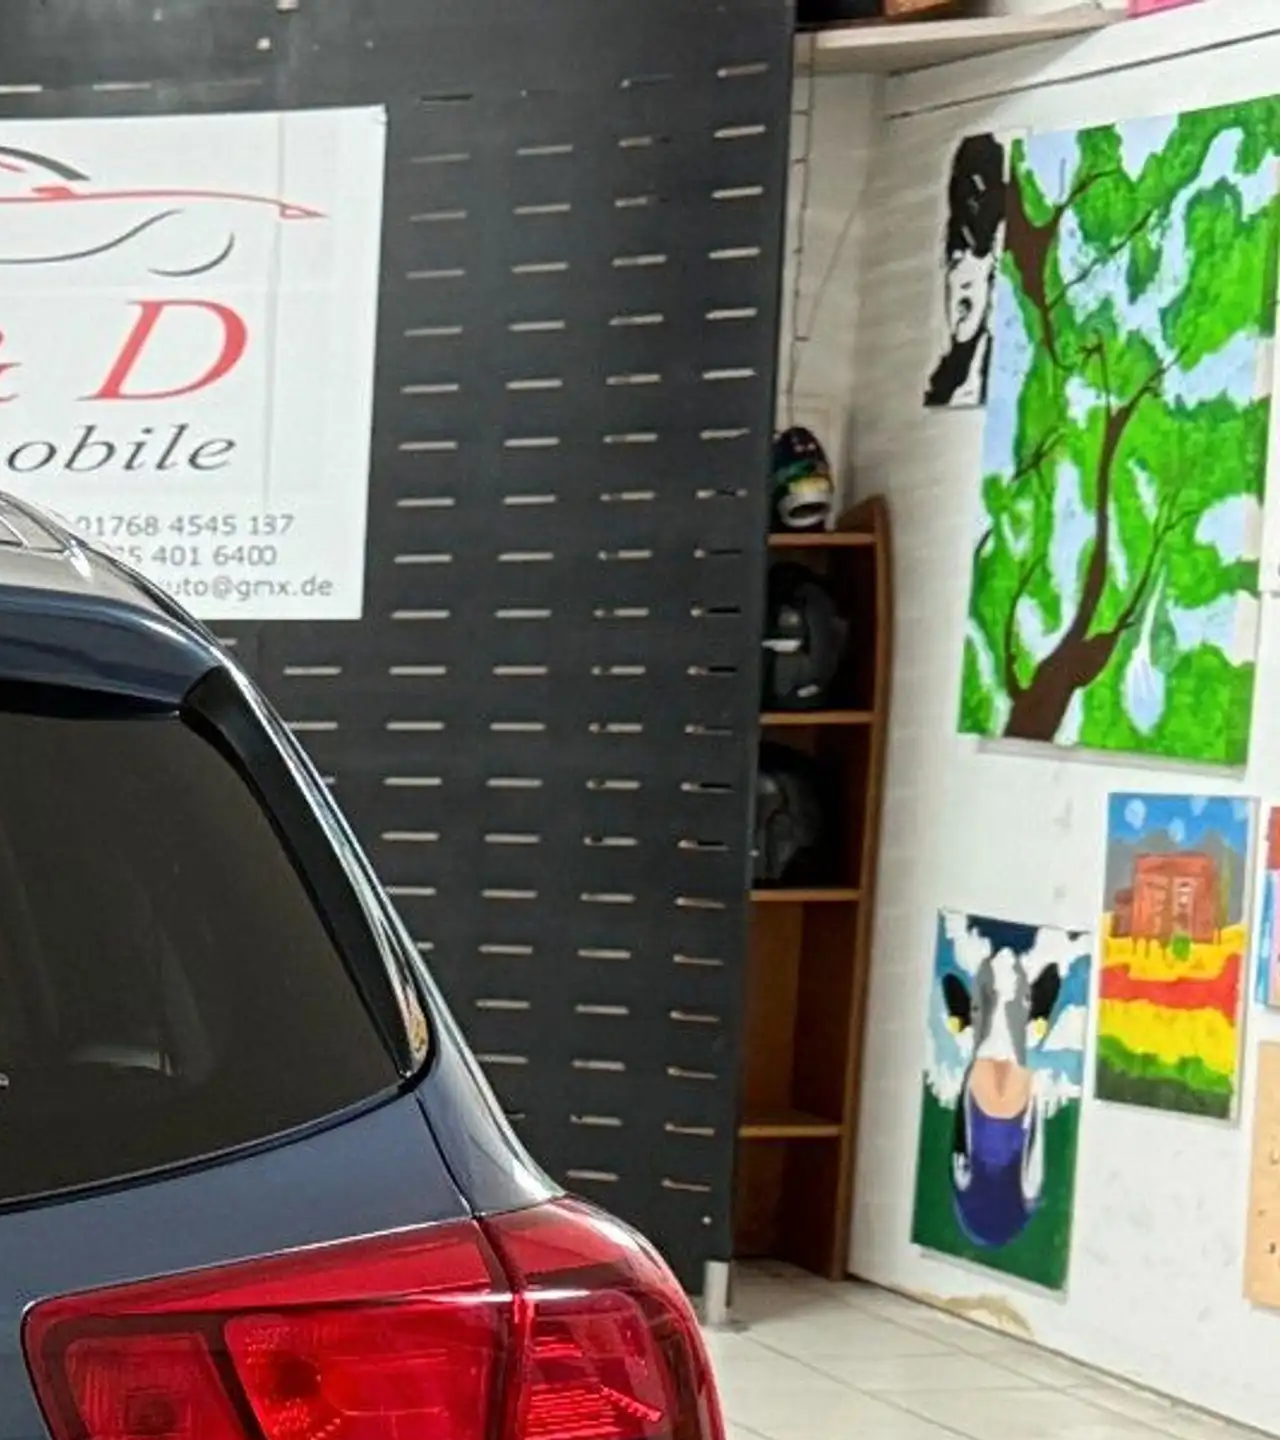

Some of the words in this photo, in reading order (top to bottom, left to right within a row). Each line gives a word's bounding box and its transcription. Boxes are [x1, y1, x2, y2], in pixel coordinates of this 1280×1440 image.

[77, 299, 248, 401] D
[167, 514, 237, 536] 4545
[249, 514, 295, 535] 137
[151, 545, 202, 567] 401
[212, 545, 278, 566] 6400
[159, 575, 334, 601] uto@gmx.de
